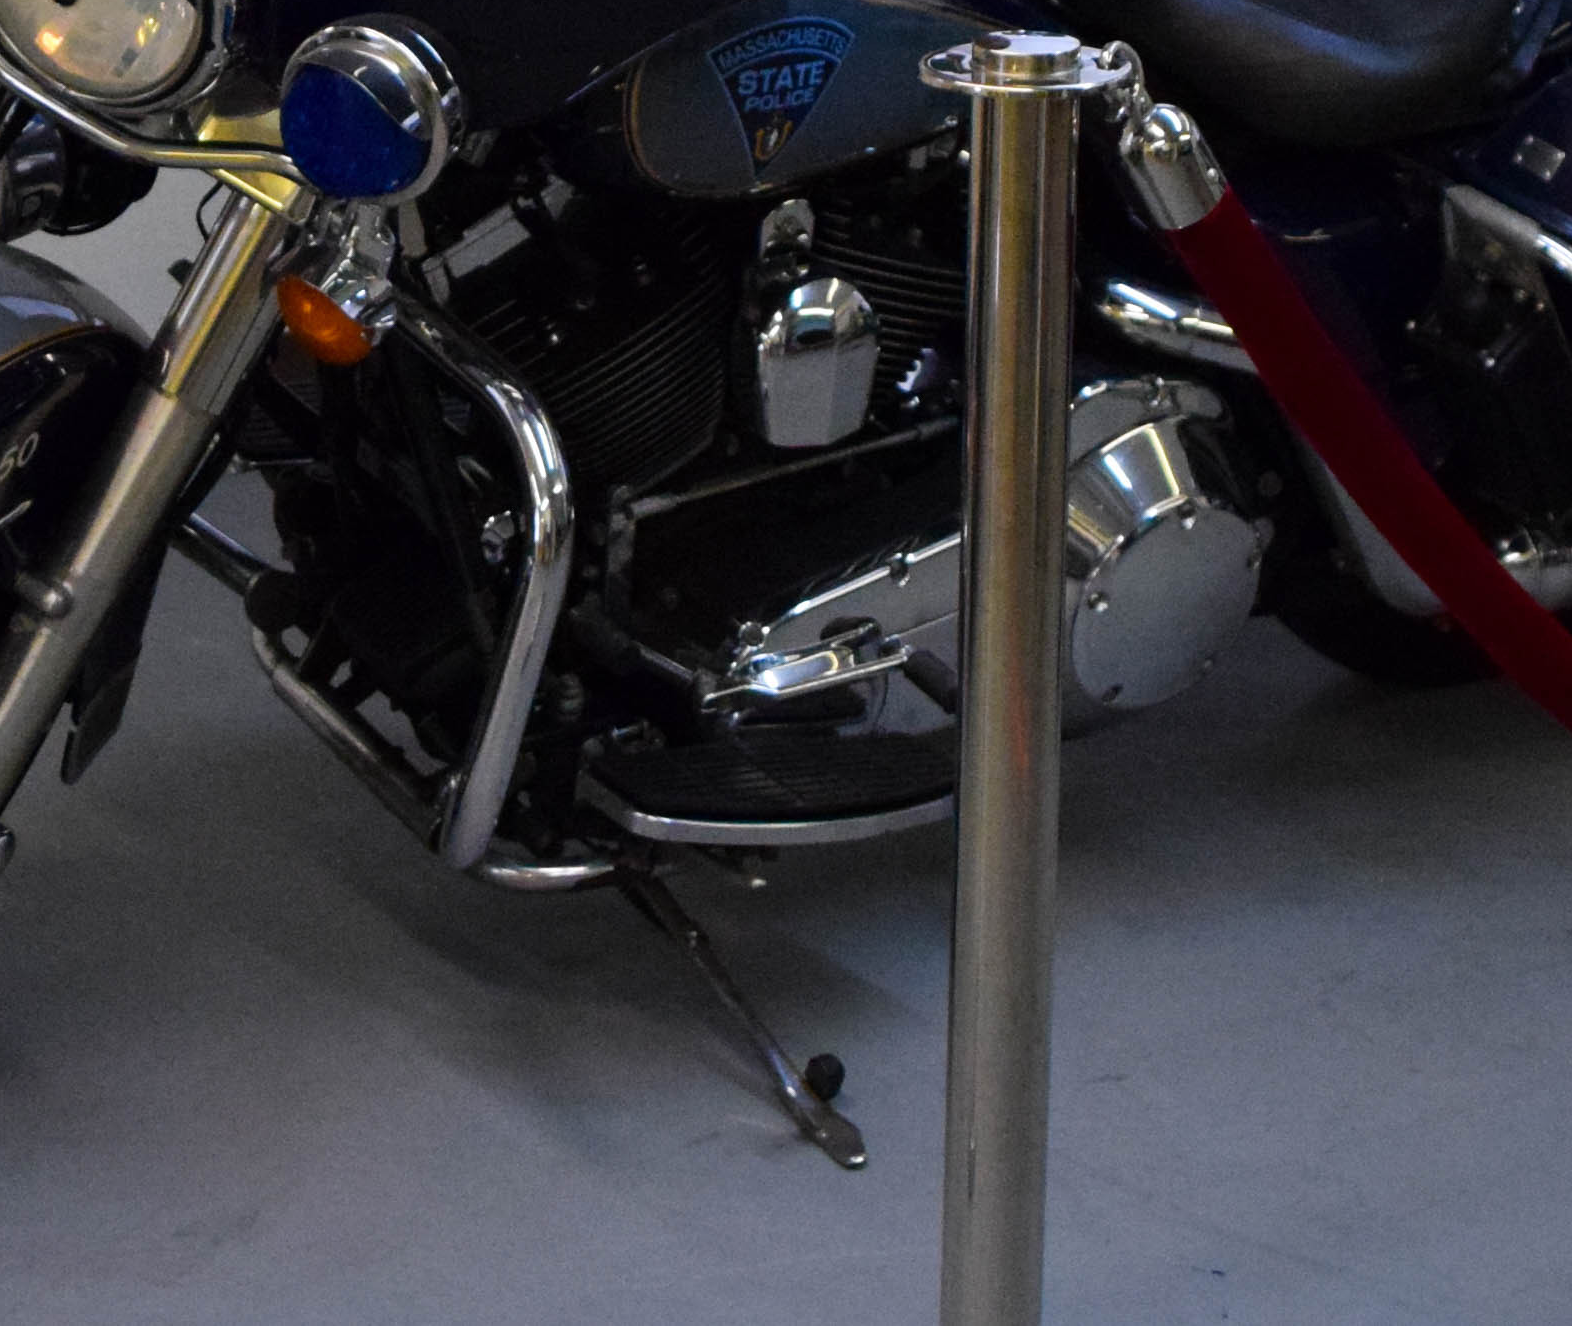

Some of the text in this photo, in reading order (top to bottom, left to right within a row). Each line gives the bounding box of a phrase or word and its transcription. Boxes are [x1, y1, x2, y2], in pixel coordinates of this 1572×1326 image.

[719, 26, 846, 69] MASSACHUSETTS
[738, 60, 826, 96] STATE
[744, 86, 815, 112] POLICE
